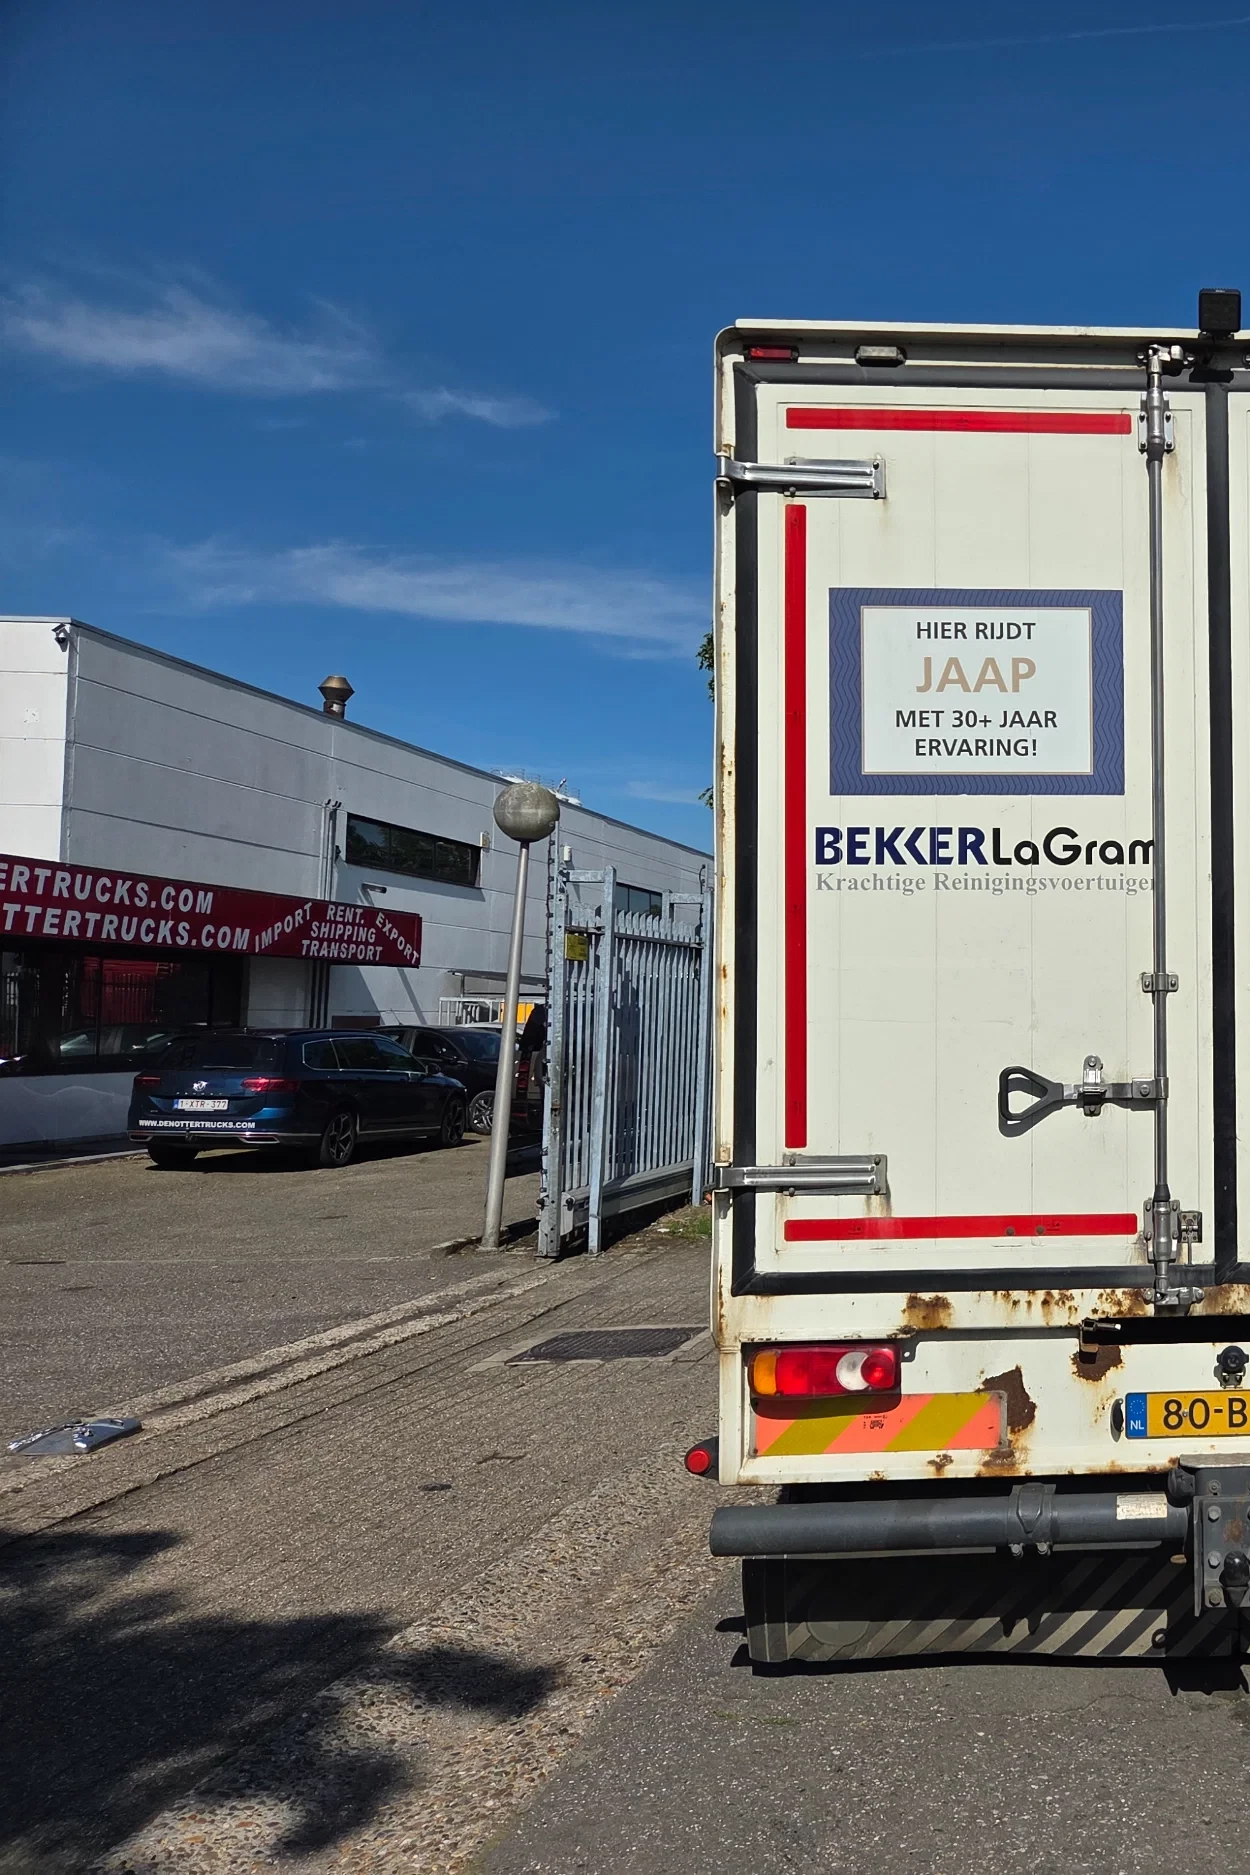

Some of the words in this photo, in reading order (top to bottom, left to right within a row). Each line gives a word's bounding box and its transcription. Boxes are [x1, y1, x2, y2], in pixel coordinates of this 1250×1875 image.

[916, 621, 968, 640] HIER
[975, 621, 1036, 640] RIJDT
[915, 656, 1036, 693] JAAP
[895, 710, 944, 728] MET
[951, 710, 992, 728] 30+
[999, 710, 1058, 728] JAAR
[914, 738, 1038, 757] ERVARING!
[815, 871, 926, 896] Krachtige
[932, 871, 1155, 897] Reinigingsvoertuige
[326, 904, 365, 924] RENT.
[254, 902, 313, 953] IMPORT
[310, 921, 376, 943] SHIPPING
[375, 911, 419, 965] EXPORT
[301, 939, 383, 961] TRANSPORT
[138, 1119, 256, 1129] WWW.DENOTTERTRUCKS.COM
[1130, 1419, 1145, 1431] NL
